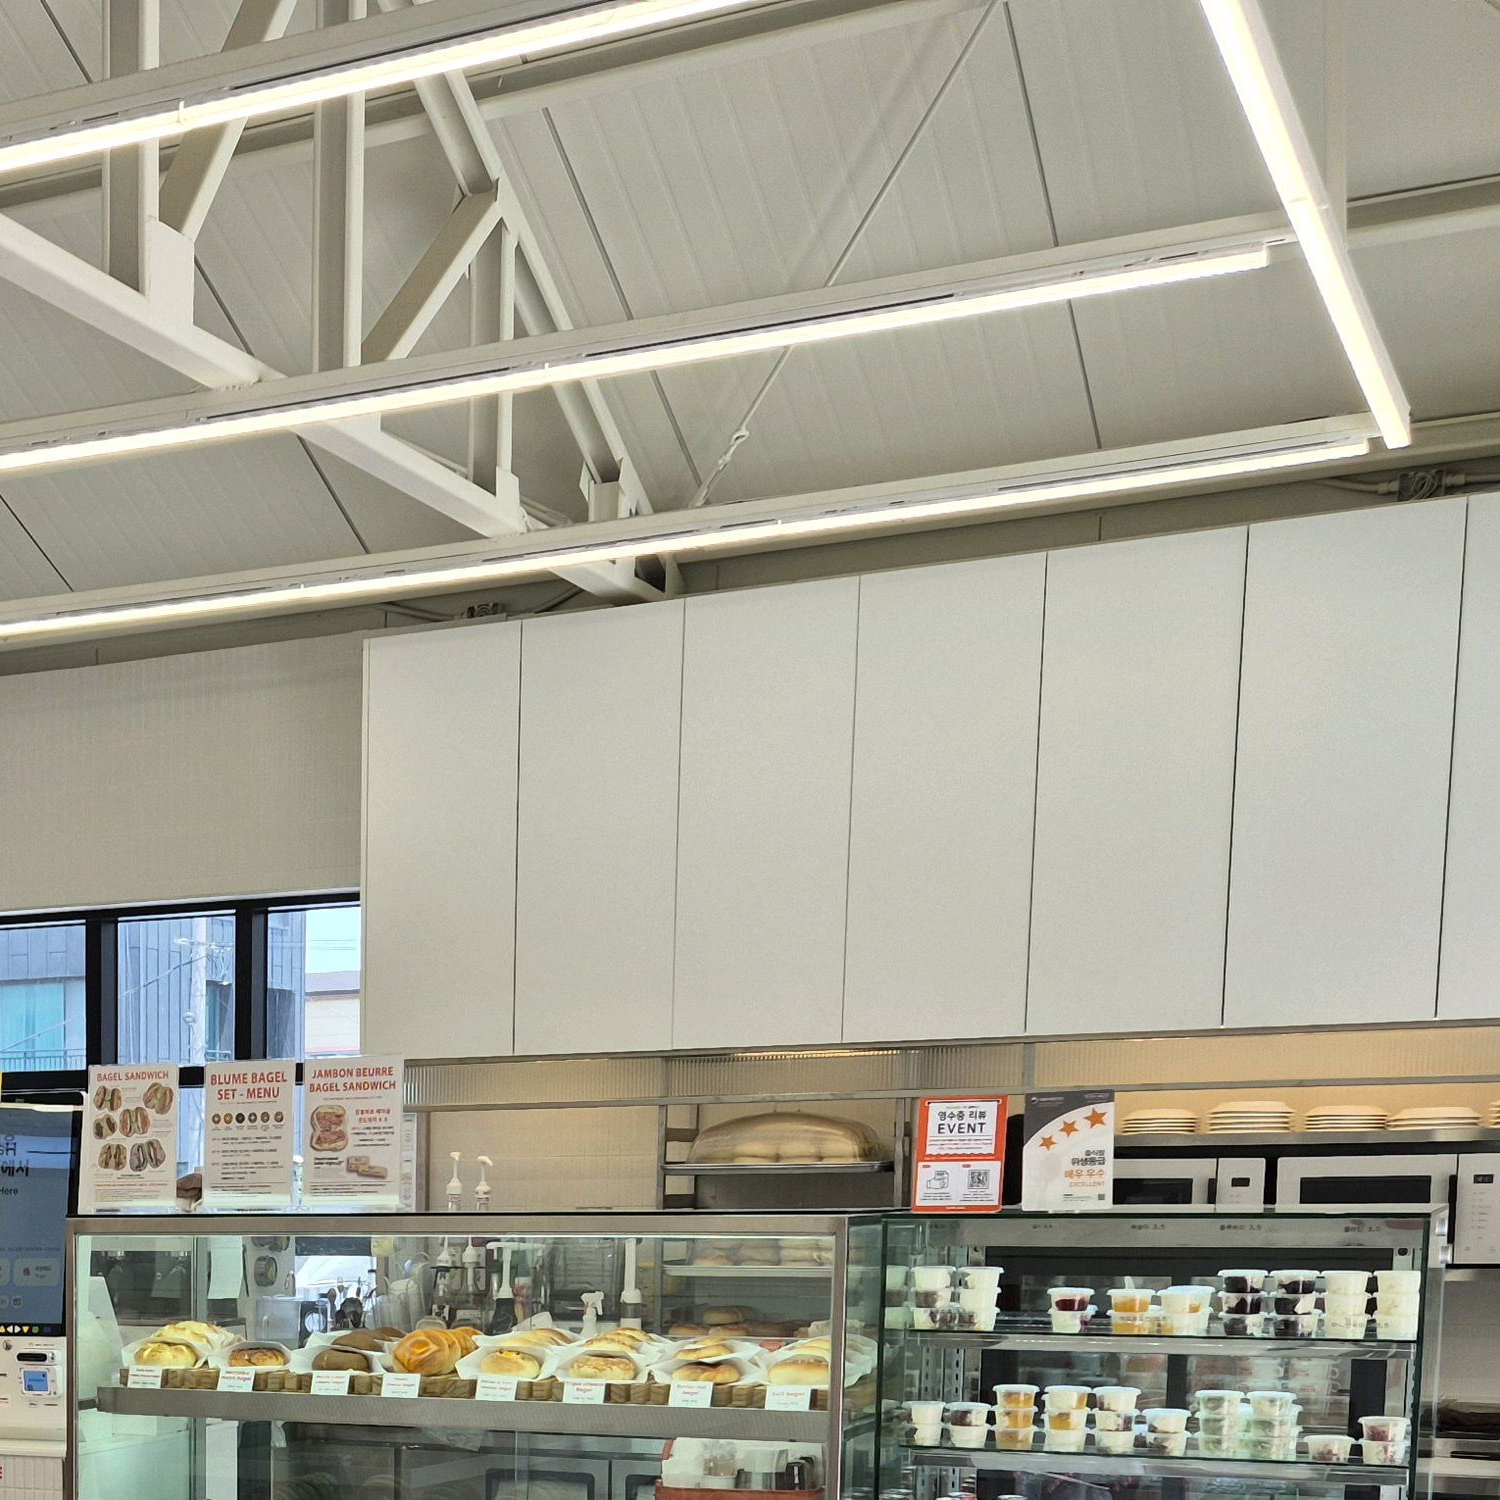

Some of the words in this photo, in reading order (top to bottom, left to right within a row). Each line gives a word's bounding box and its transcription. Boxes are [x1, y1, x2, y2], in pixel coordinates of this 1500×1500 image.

[97, 1072, 123, 1082] BAGEL
[124, 1070, 169, 1081] SANDWICH
[210, 1072, 248, 1086] BLUME
[251, 1071, 287, 1084] BAGEL
[311, 1068, 354, 1079] JAMBON
[356, 1066, 394, 1077] BEURRE
[217, 1088, 237, 1100] SET
[246, 1086, 280, 1099] MENU
[309, 1082, 340, 1093] BAGEL
[342, 1080, 396, 1092] SANDWICH
[968, 1110, 987, 1120] 리뷰
[937, 1122, 987, 1134] EVENT
